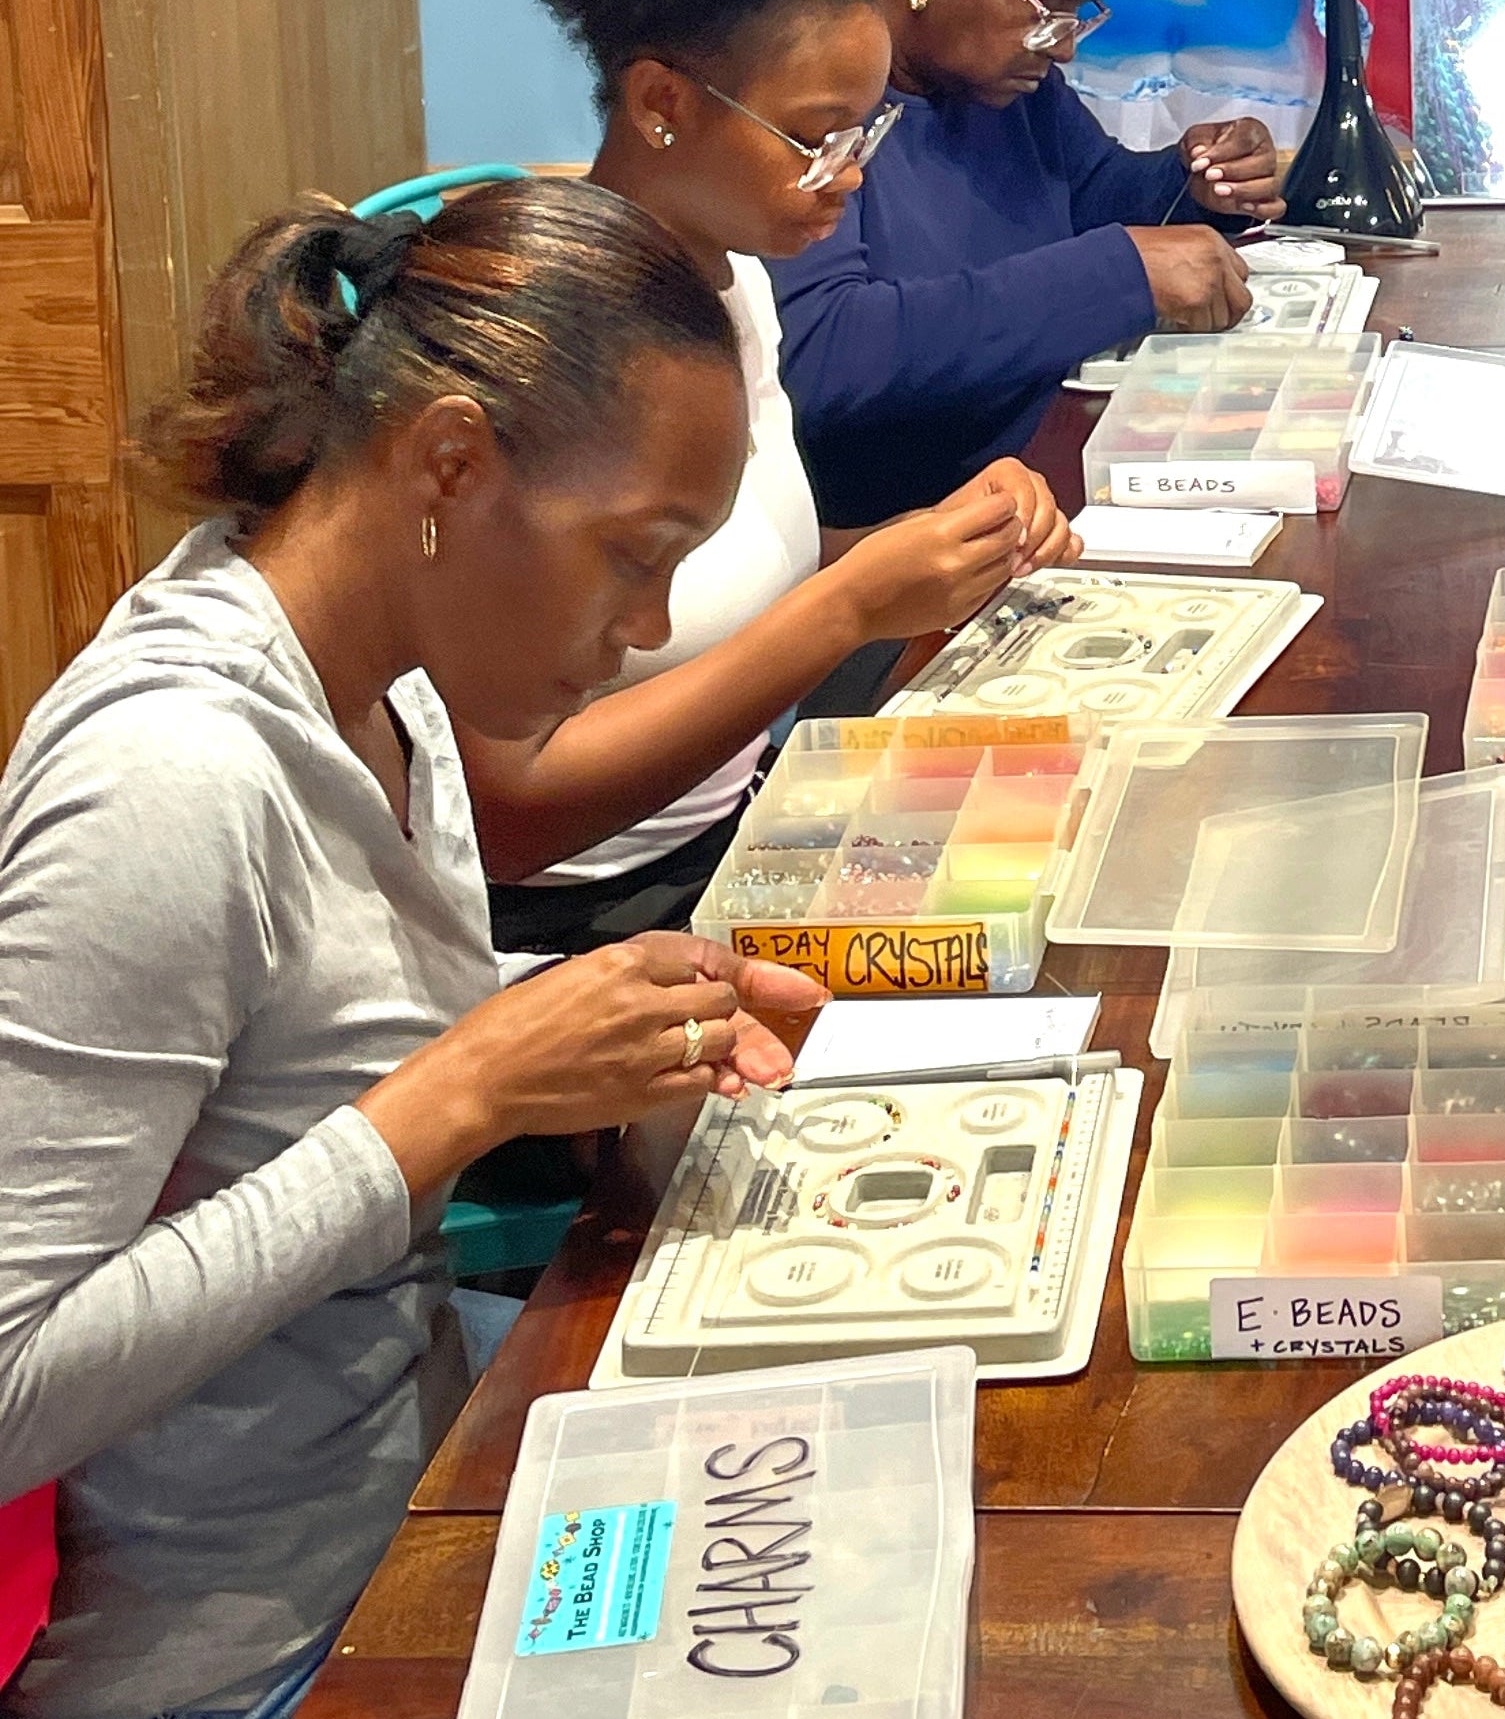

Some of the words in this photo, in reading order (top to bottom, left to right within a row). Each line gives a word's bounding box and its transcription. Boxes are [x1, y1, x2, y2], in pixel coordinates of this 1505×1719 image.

[1127, 476, 1143, 493] E
[1156, 477, 1236, 493] BEADS
[845, 930, 988, 989] CRYSTALS
[1291, 1298, 1402, 1329] BEADS
[1273, 1336, 1406, 1356] CRYSTALS
[582, 1518, 607, 1558] SHOP
[687, 1435, 817, 1678] CHARMS
[573, 1562, 599, 1604] BEAD
[566, 1607, 591, 1641] THE
